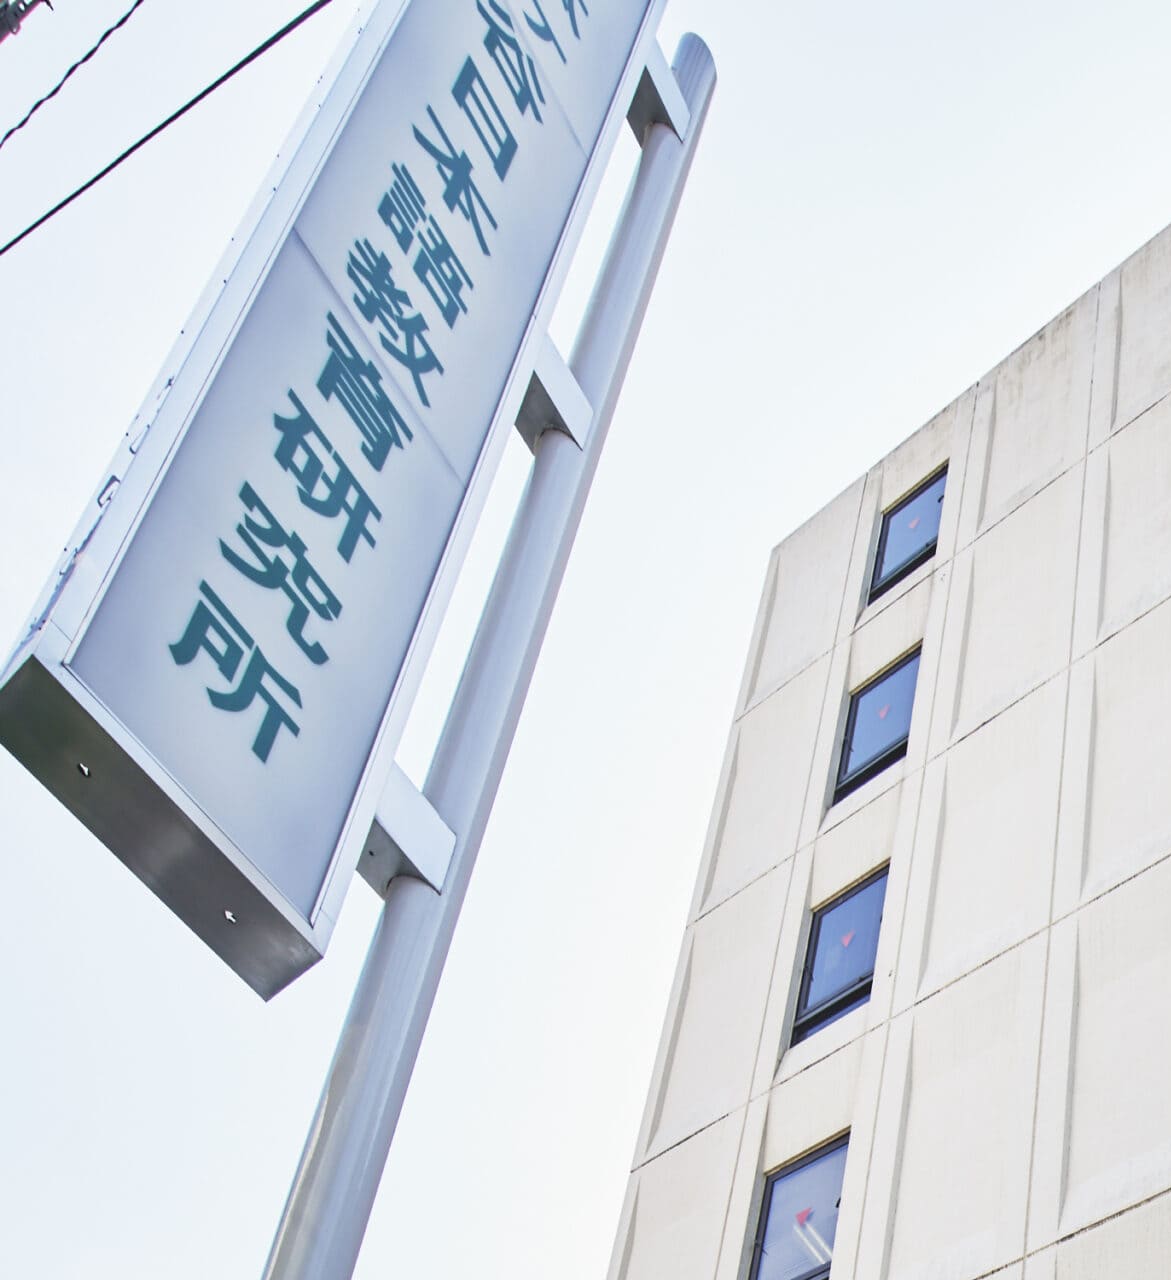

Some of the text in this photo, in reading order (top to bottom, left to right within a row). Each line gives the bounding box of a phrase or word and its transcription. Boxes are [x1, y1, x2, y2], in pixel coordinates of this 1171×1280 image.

[169, 0, 590, 764] ヶ谷日本語教育研究所
